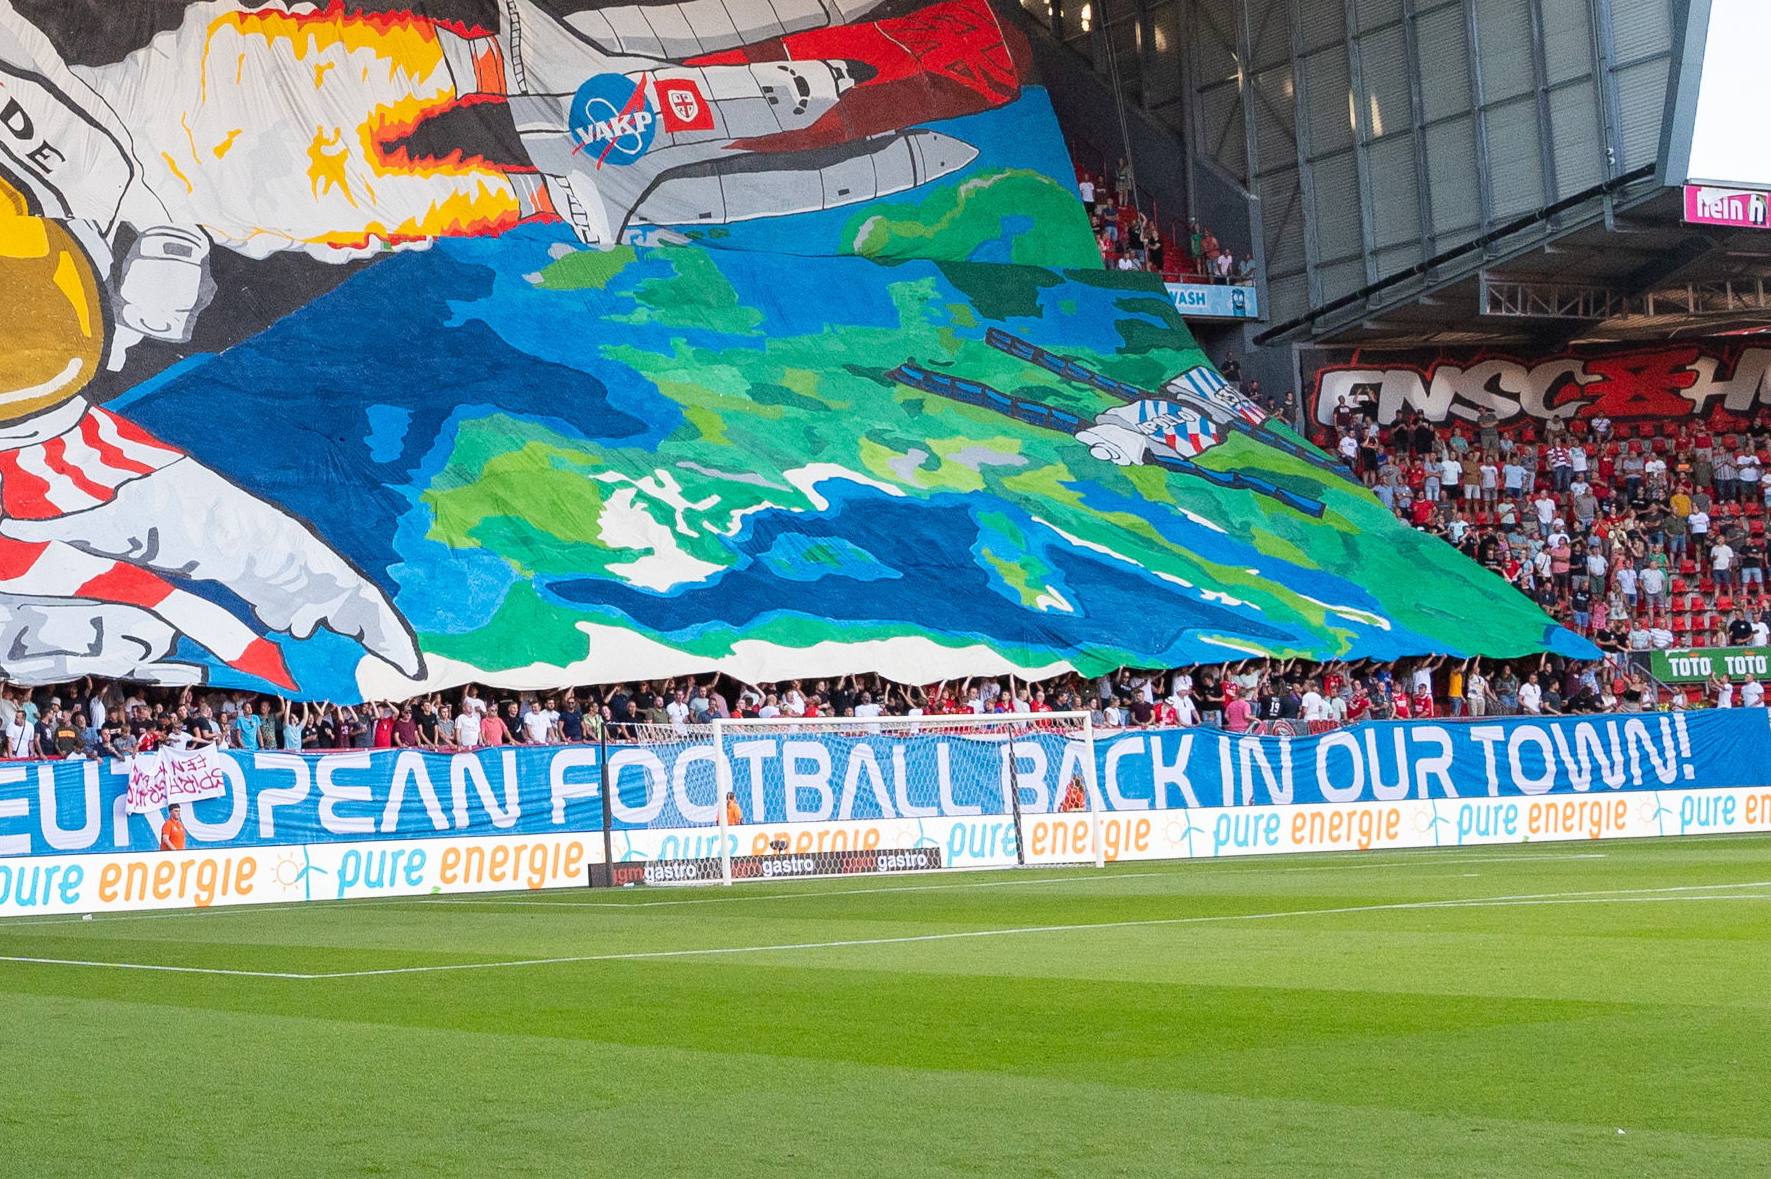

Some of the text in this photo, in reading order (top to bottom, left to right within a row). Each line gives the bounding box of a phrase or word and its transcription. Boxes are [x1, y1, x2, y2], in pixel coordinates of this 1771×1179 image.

[575, 111, 652, 144] VAKP
[1668, 655, 1768, 677] TOTO TOTO
[551, 739, 996, 826] FOOTBALL
[1003, 733, 1201, 813] BACK
[1218, 736, 1294, 806] IN
[1315, 725, 1459, 803] OUR
[1470, 713, 1695, 798] TOWN!
[1213, 808, 1401, 857] pure energie
[1457, 799, 1628, 845] pure energie
[1680, 795, 1736, 835] pure
[947, 821, 1019, 868] pure
[98, 856, 258, 908] energie
[337, 840, 584, 899] pure energie
